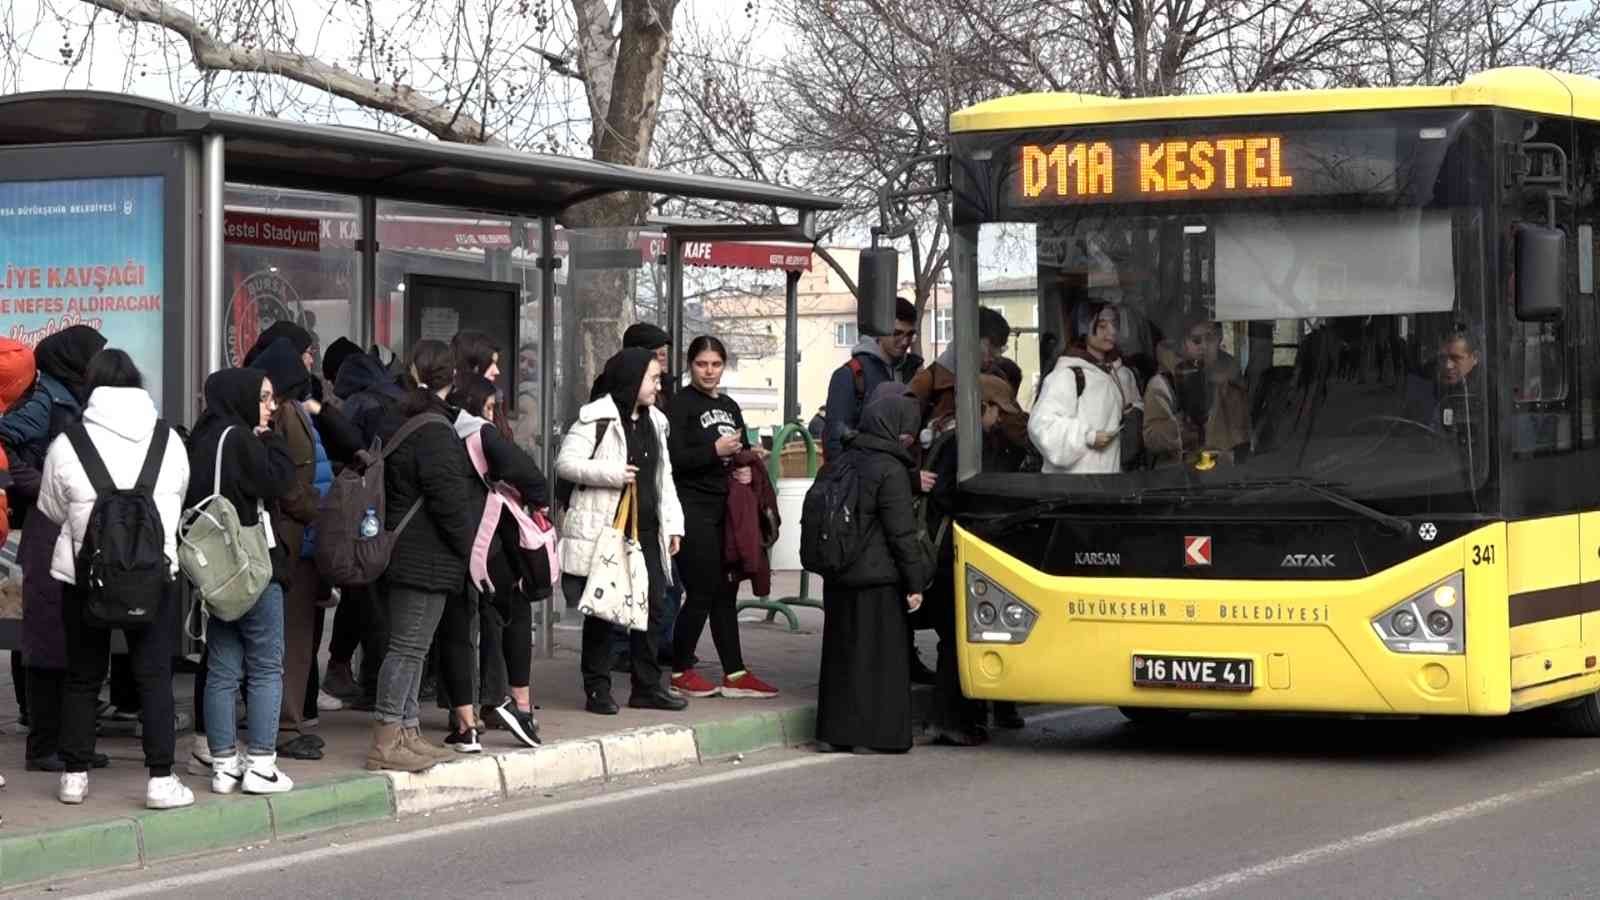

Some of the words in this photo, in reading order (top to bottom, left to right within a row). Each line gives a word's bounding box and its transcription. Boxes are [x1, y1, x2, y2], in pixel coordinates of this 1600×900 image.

[1023, 142, 1113, 197] D11A
[1139, 137, 1293, 193] KESTEL
[263, 223, 319, 246] Stadyum
[684, 241, 713, 259] KAFE
[47, 256, 145, 294] KAVŞAĞI
[14, 297, 64, 313] NEFES
[66, 294, 161, 312] ALDIRACAK
[1074, 552, 1121, 566] KARSAN
[1281, 553, 1337, 568] ATAK
[1471, 544, 1496, 566] 341
[1068, 599, 1168, 619] BÜYÜKŞEHİR
[1219, 603, 1330, 622] BELEDİYESİ
[1146, 659, 1167, 681] 16
[1171, 660, 1217, 683] NVE
[1223, 662, 1247, 684] 41
